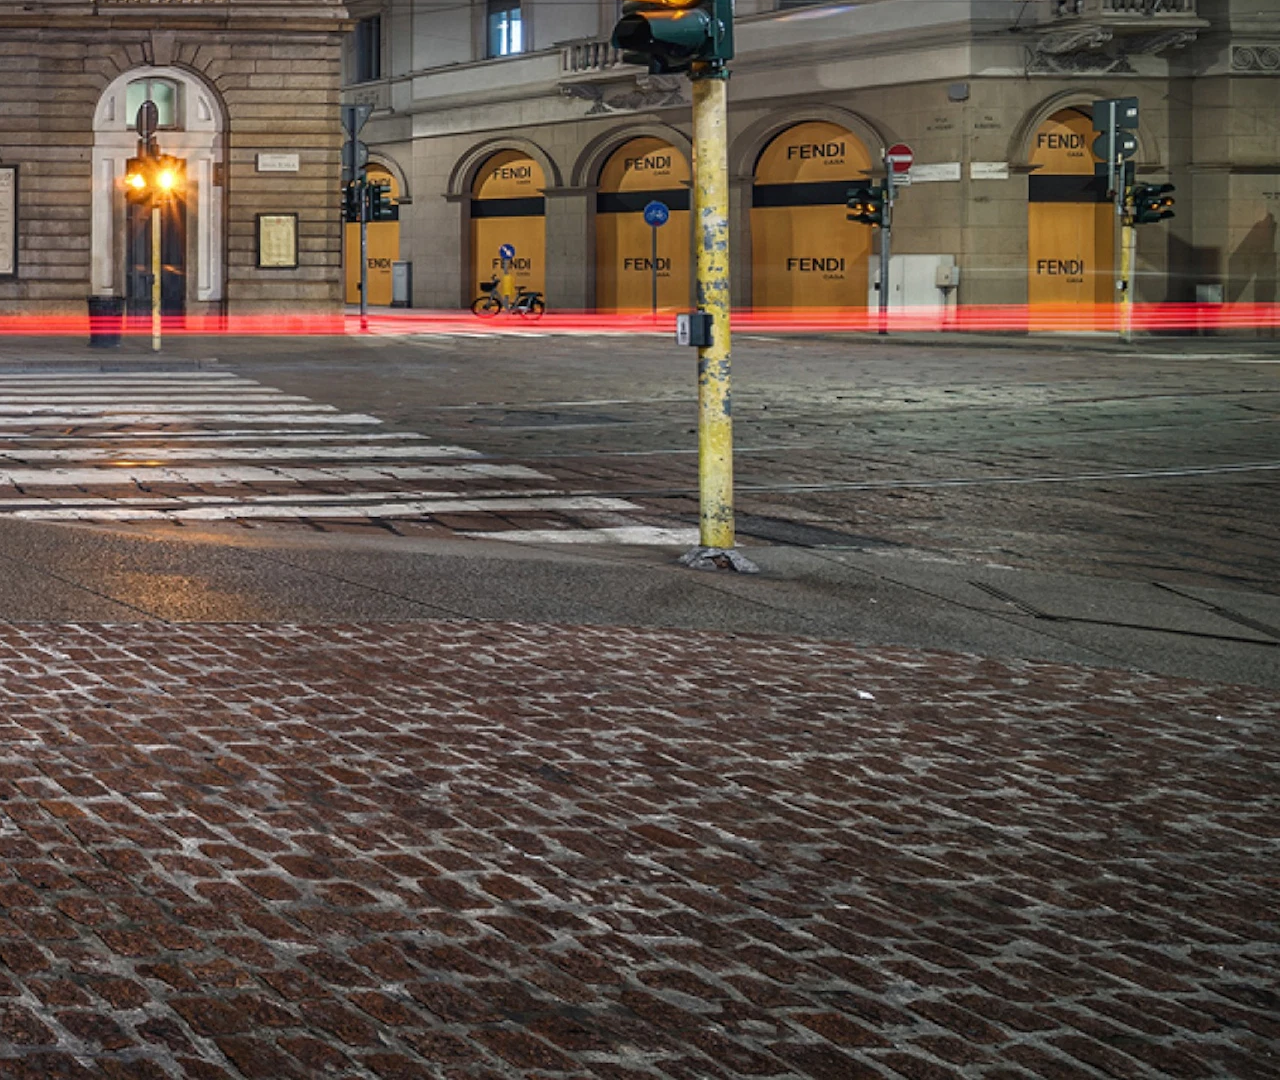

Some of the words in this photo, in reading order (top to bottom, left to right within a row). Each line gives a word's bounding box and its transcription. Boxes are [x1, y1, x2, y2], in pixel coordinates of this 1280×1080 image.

[1038, 134, 1084, 149] FENDI
[788, 142, 845, 160] FENDI
[624, 156, 671, 171] FENDI
[493, 166, 531, 180] FENDI
[367, 258, 391, 270] ENDI
[624, 258, 671, 271] FENDI
[787, 258, 845, 271] FENDI
[1037, 260, 1084, 275] FENDI
